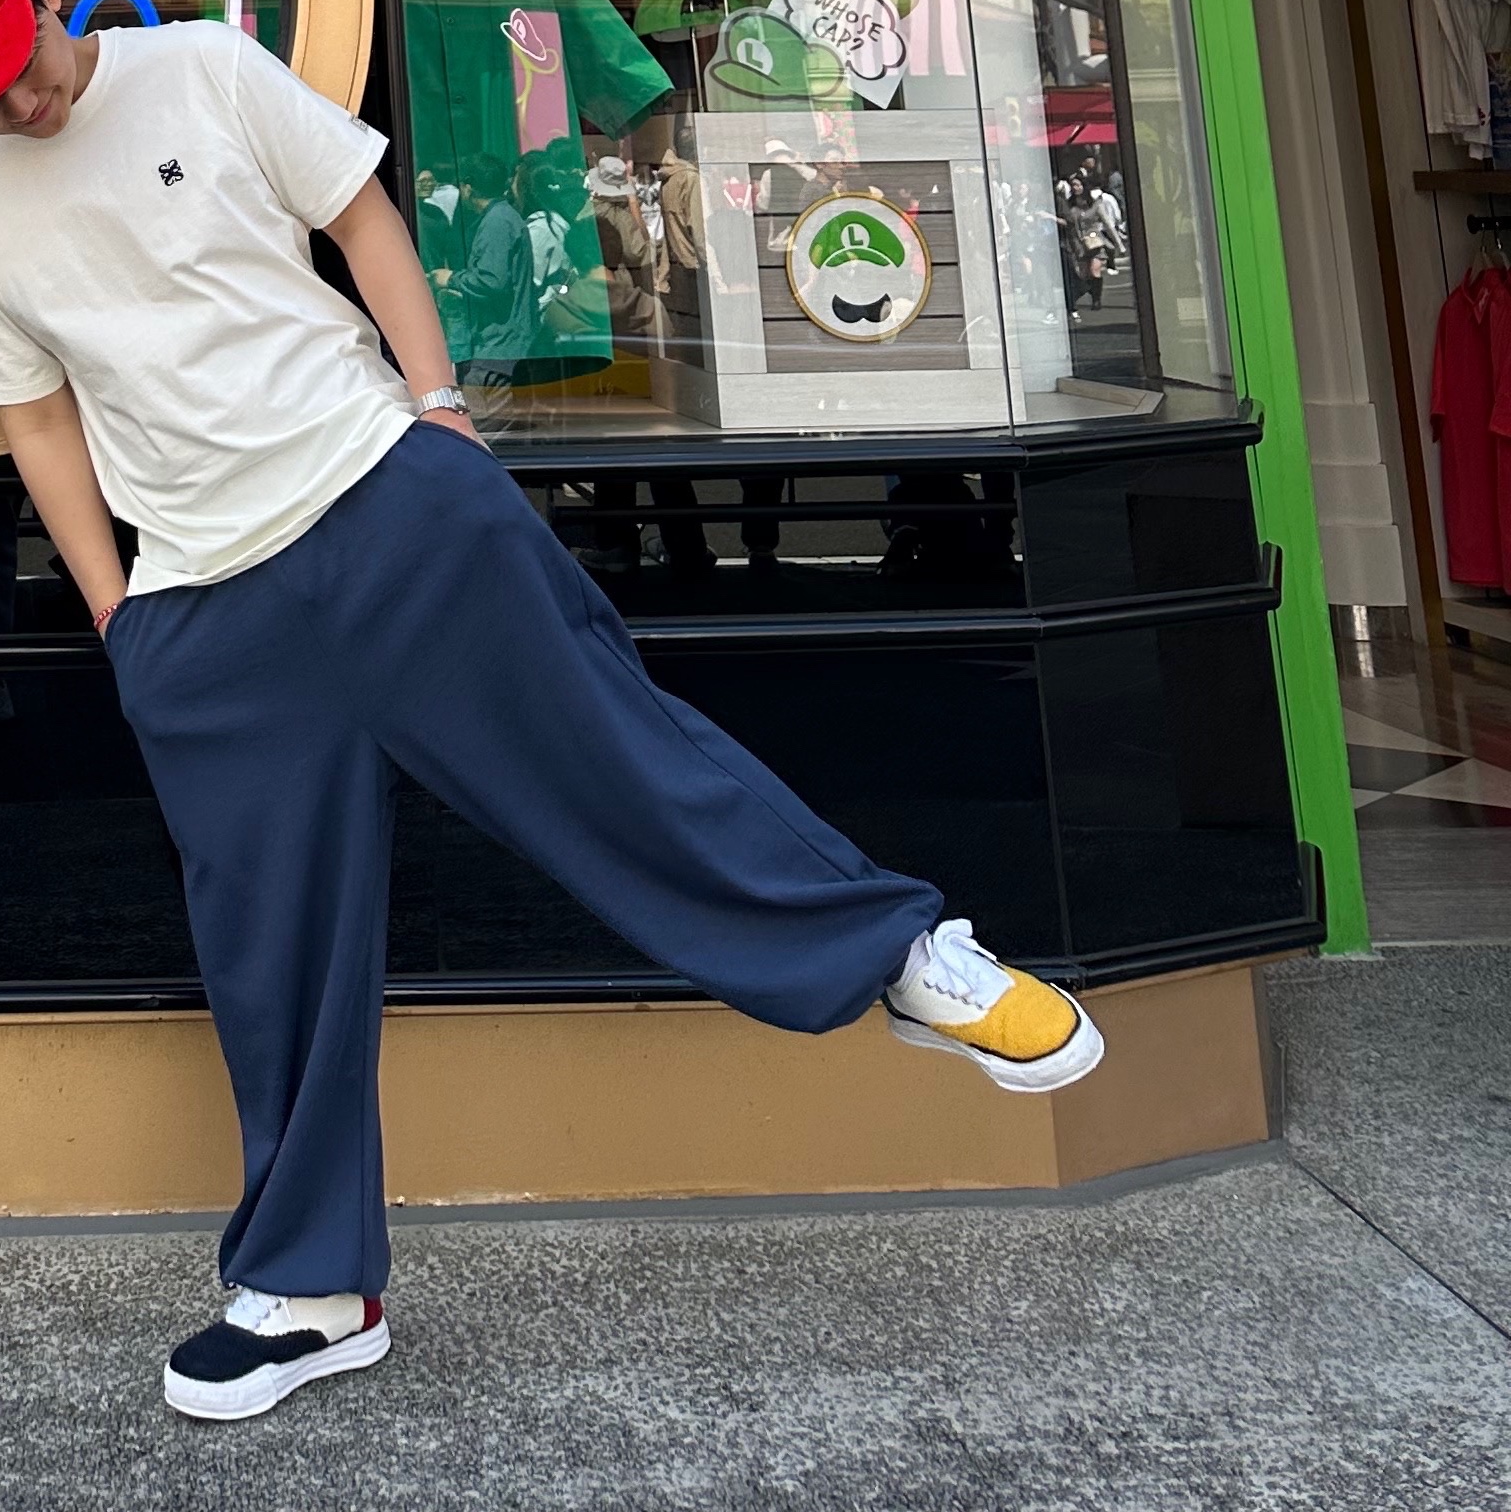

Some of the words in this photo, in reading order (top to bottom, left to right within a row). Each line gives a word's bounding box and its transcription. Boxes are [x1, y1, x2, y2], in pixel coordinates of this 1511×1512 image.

[812, 16, 865, 56] CAP?
[744, 42, 764, 69] L
[847, 226, 864, 246] L
